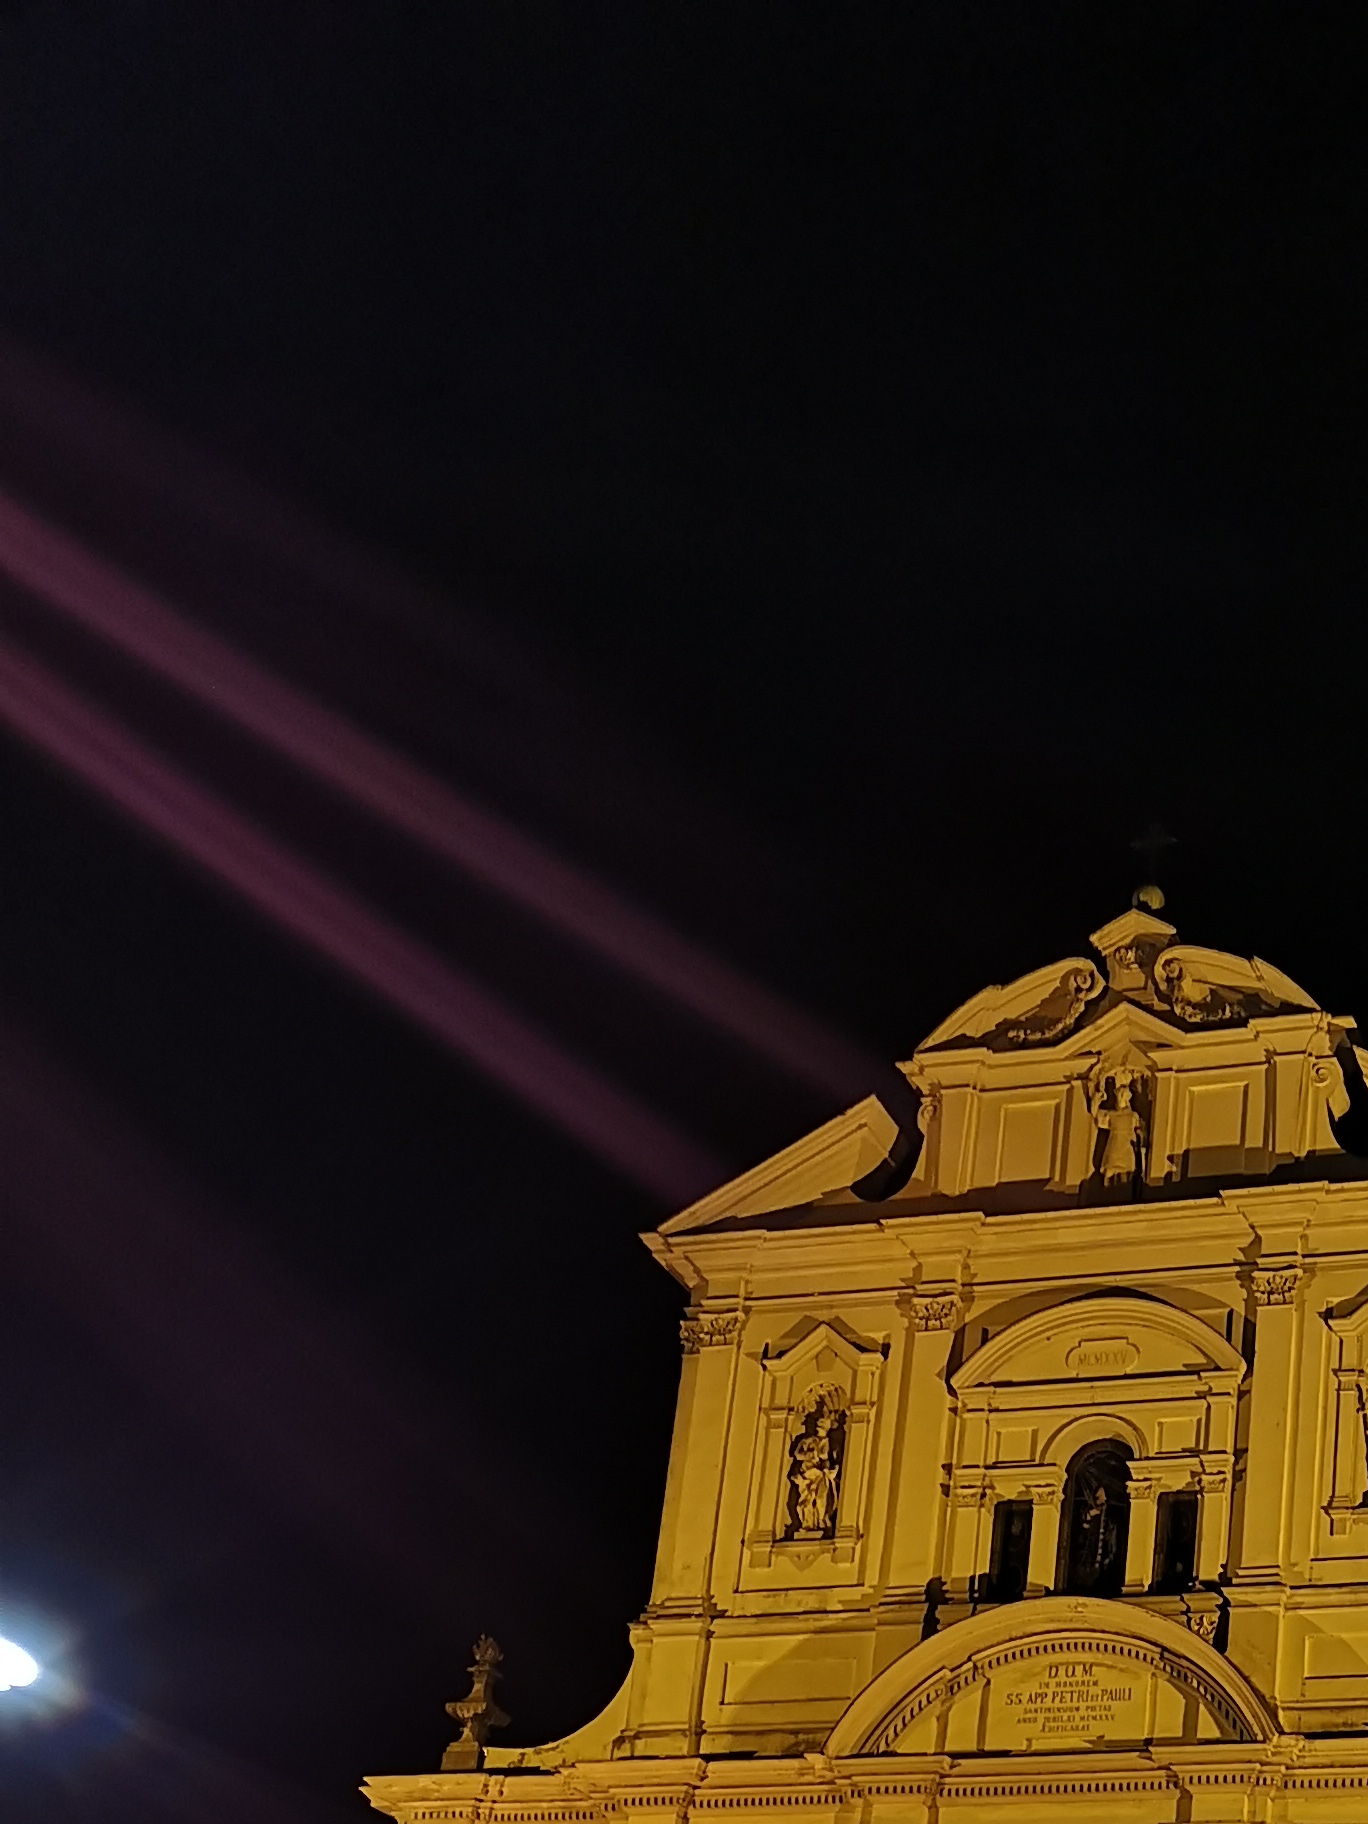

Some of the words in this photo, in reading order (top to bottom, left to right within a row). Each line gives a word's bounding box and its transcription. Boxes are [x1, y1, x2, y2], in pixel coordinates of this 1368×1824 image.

[1055, 1679, 1099, 1688] HONOREM
[1051, 1689, 1090, 1704] PETRI
[1100, 1687, 1132, 1702] PAULI
